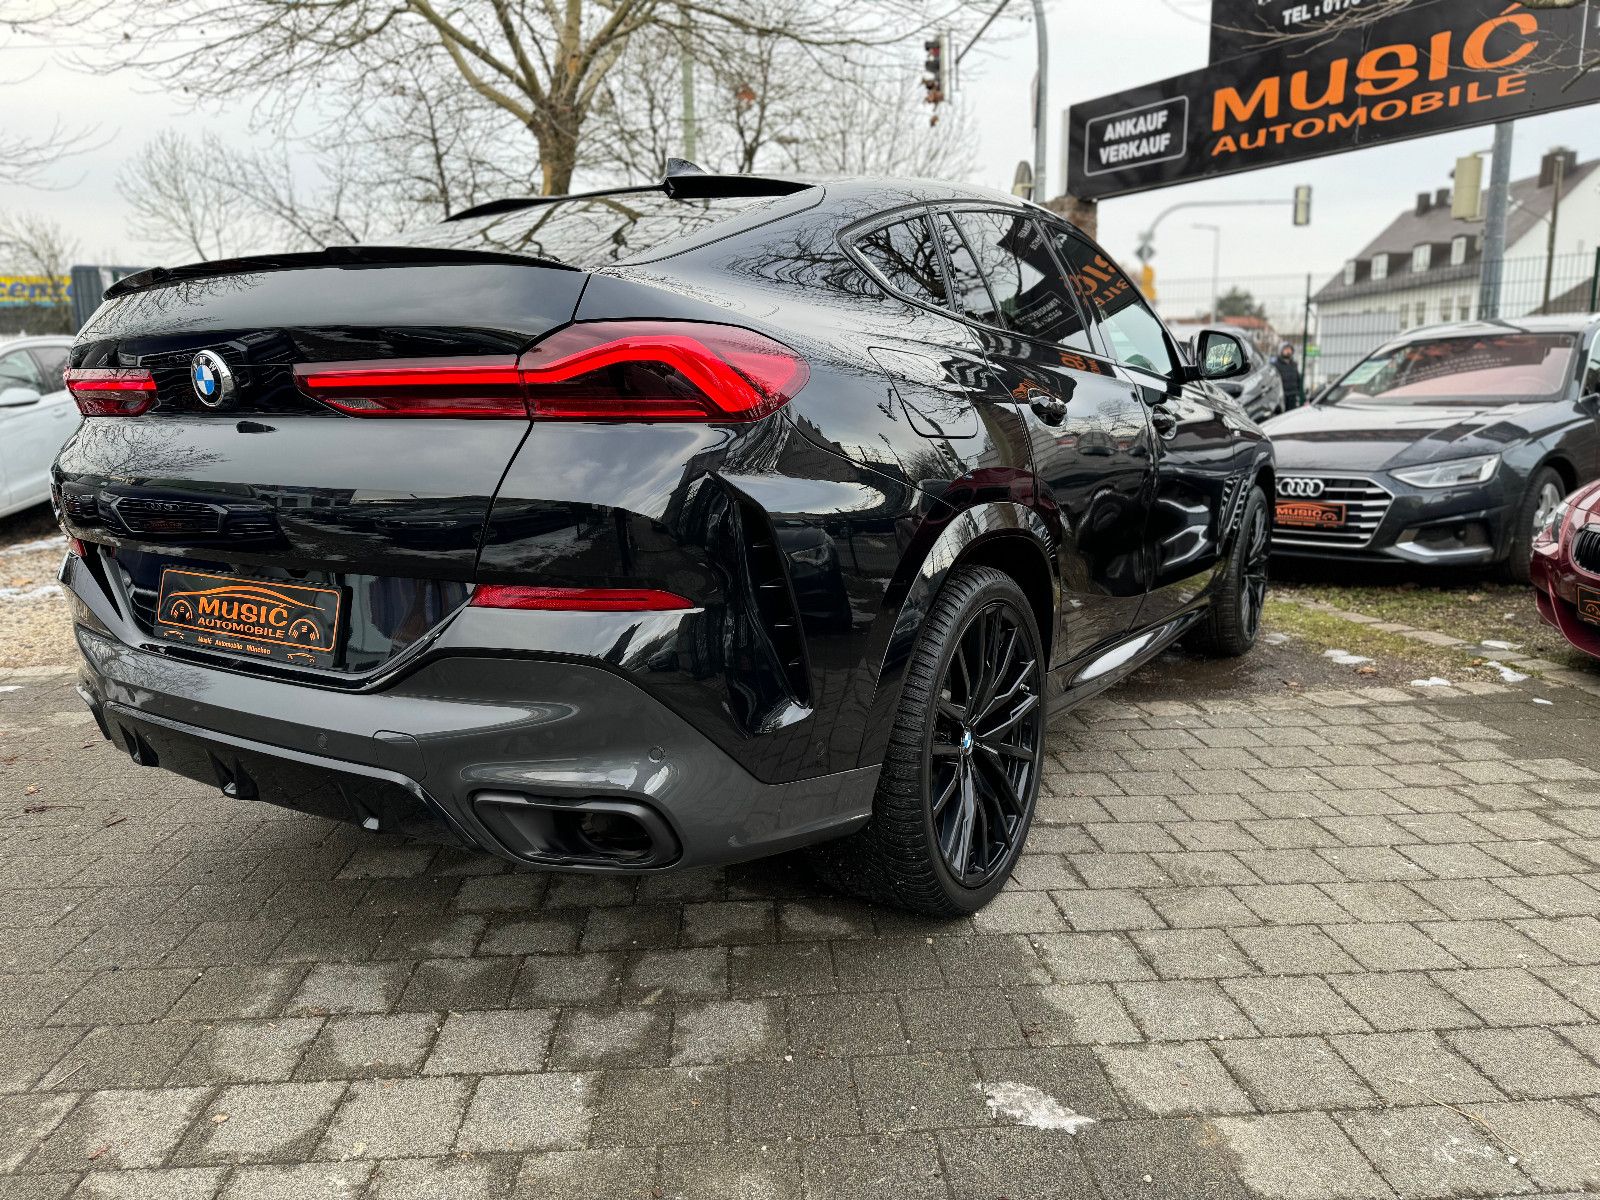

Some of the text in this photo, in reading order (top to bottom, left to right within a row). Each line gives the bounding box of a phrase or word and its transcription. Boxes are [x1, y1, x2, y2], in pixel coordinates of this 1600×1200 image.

[1212, 2, 1539, 131] MUSIĆ
[1103, 109, 1168, 142] ANKAUF
[1211, 72, 1528, 156] AUTOMOBILE
[1099, 132, 1171, 165] VERKAUF
[197, 616, 286, 639] AUTOMOBILE
